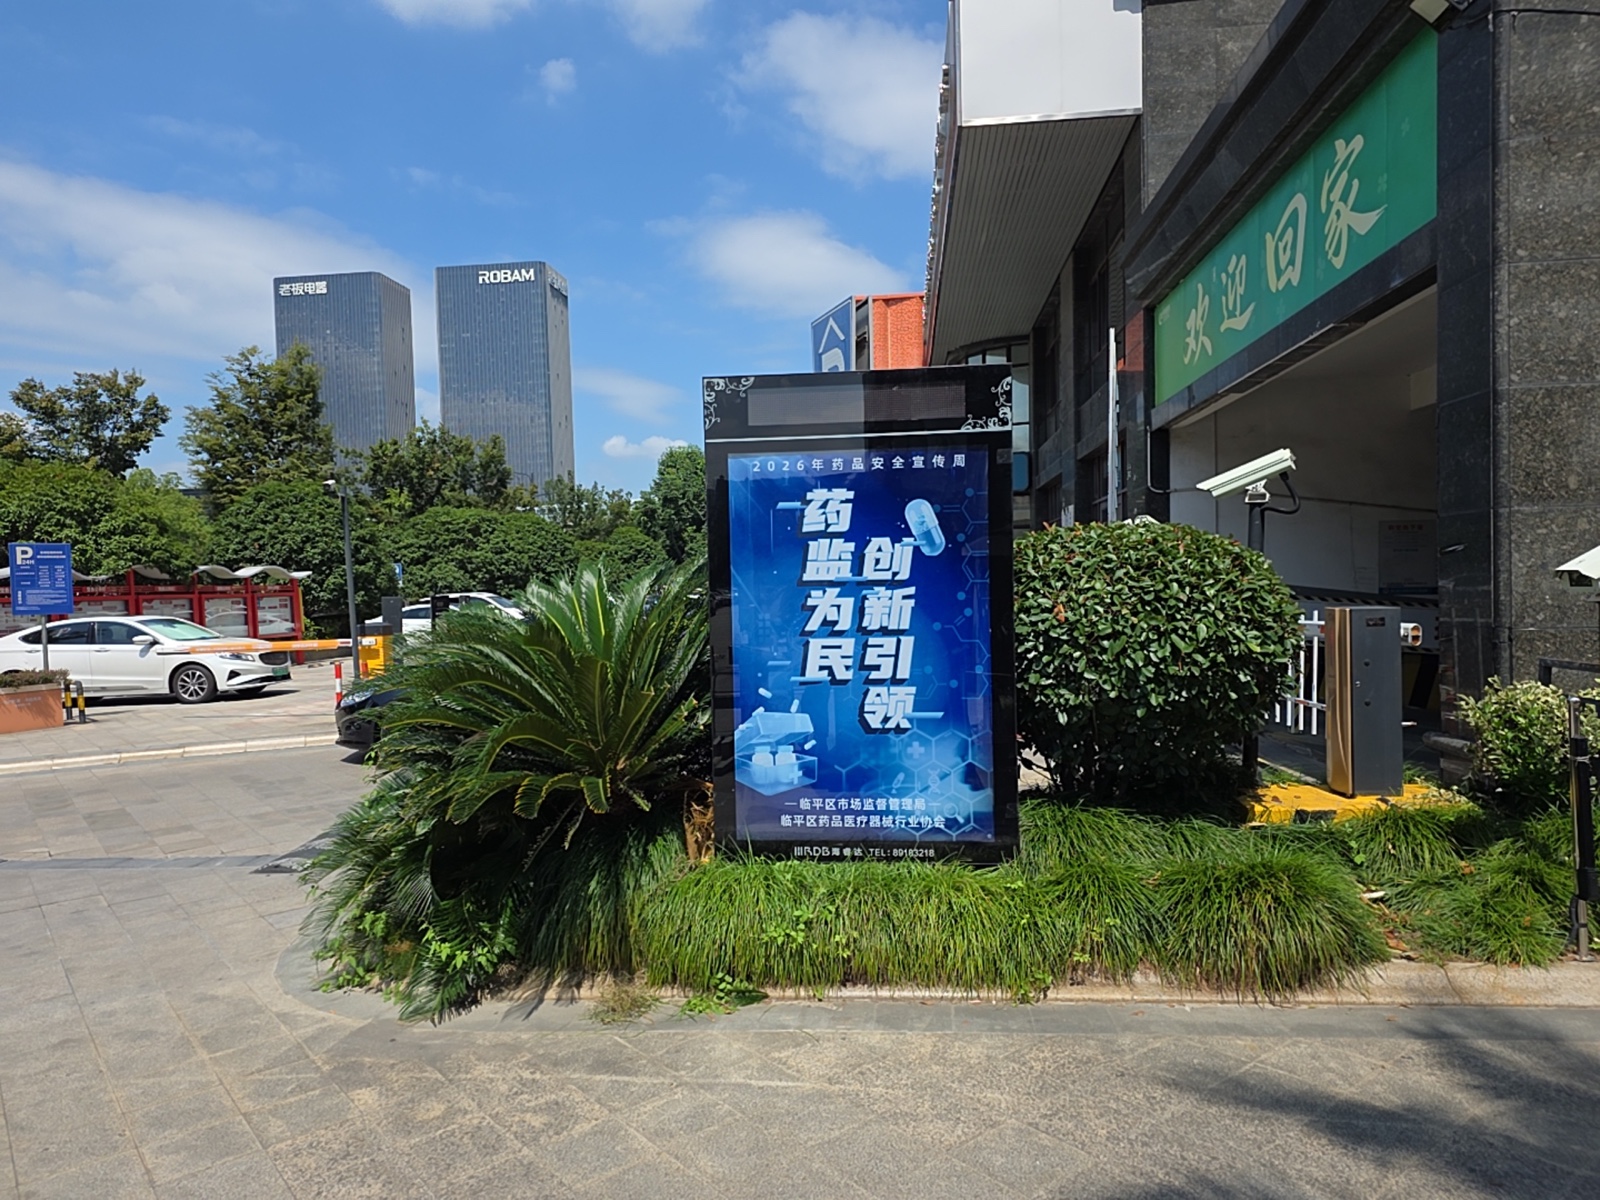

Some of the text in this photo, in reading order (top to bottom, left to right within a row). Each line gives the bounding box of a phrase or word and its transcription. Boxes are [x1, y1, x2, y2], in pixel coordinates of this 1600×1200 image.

[1183, 134, 1388, 365] 欢迎回家
[478, 268, 535, 284] ROBAM
[279, 281, 328, 297] 老板电器
[752, 454, 966, 472] 2026年药品安全宣传周
[15, 546, 33, 565] P
[802, 488, 856, 681] 药监为民
[861, 537, 917, 730] 创新引领
[799, 798, 927, 811] 临平区市场监督管理局
[780, 814, 947, 828] 临平区药品医疗器械行业协会
